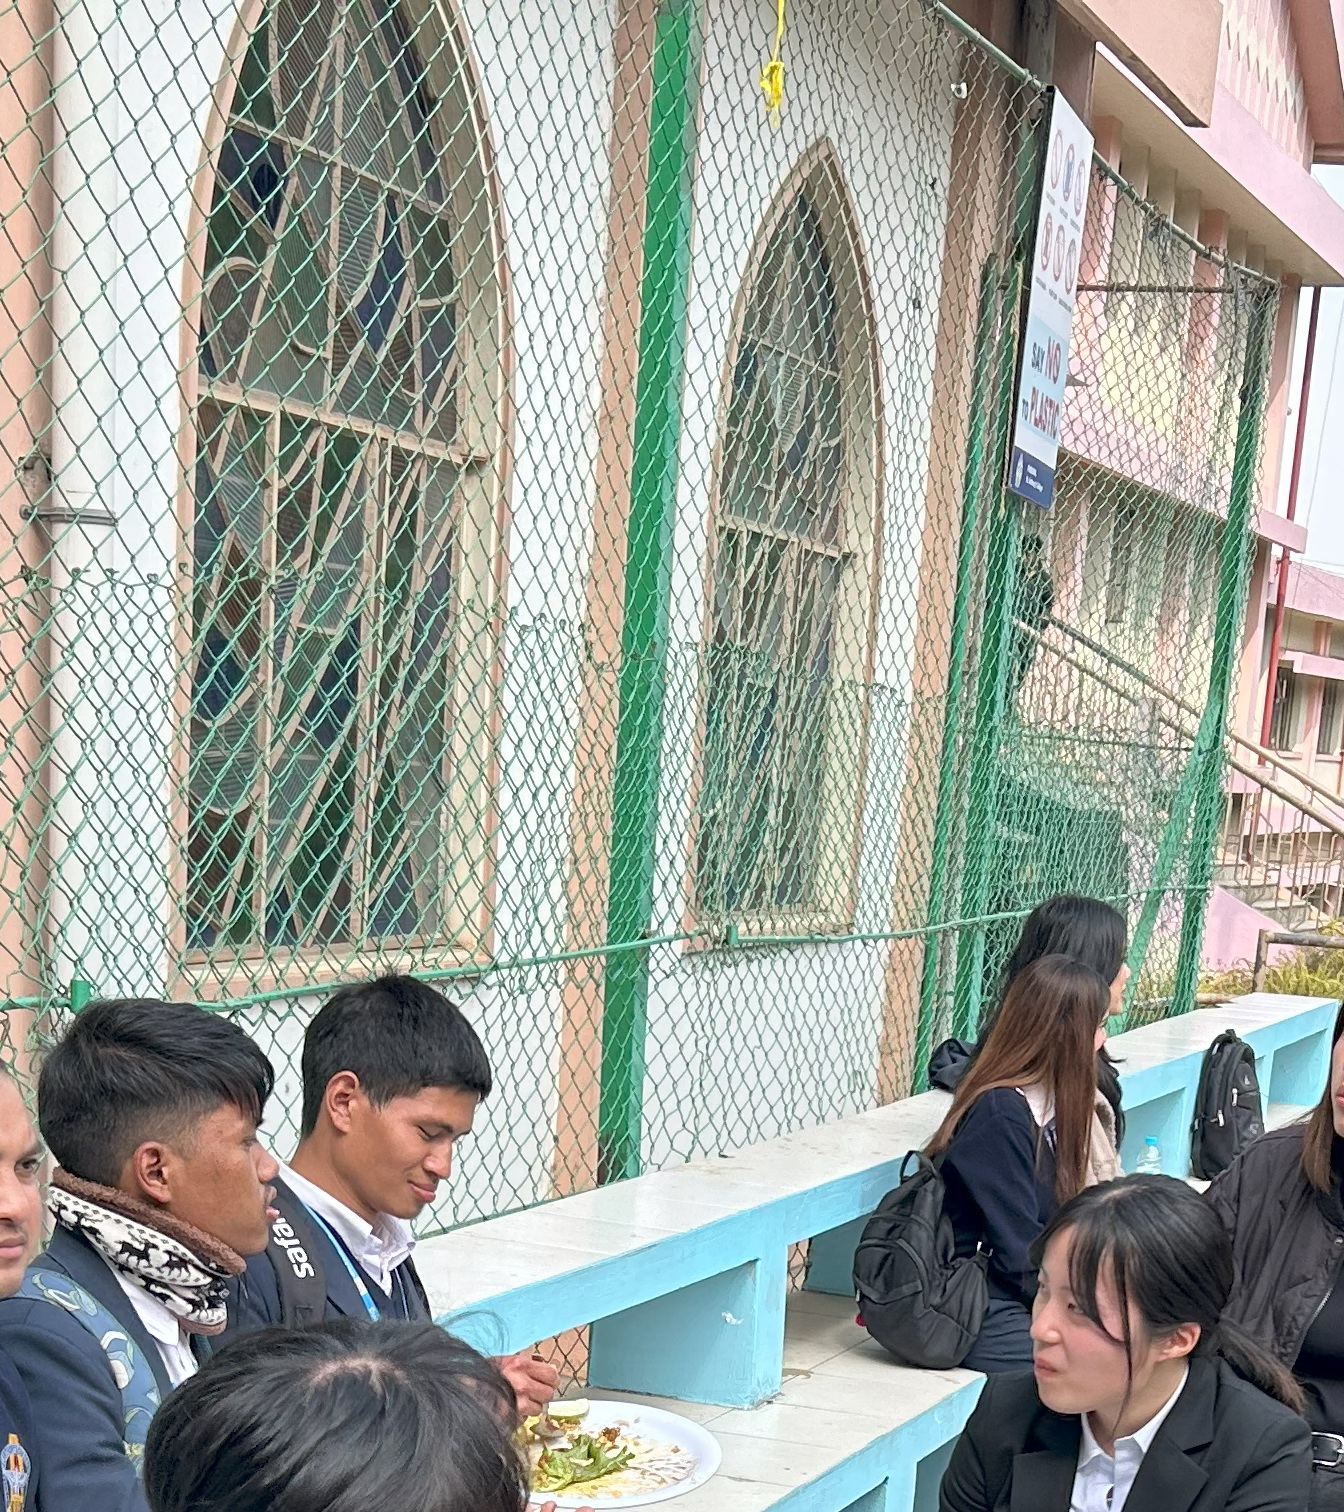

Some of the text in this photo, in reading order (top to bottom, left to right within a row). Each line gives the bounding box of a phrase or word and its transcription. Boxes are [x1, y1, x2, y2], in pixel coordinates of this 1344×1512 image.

[1031, 335, 1061, 385] SAY NO
[1029, 386, 1059, 440] PLASTIC
[272, 1209, 315, 1278] safa
